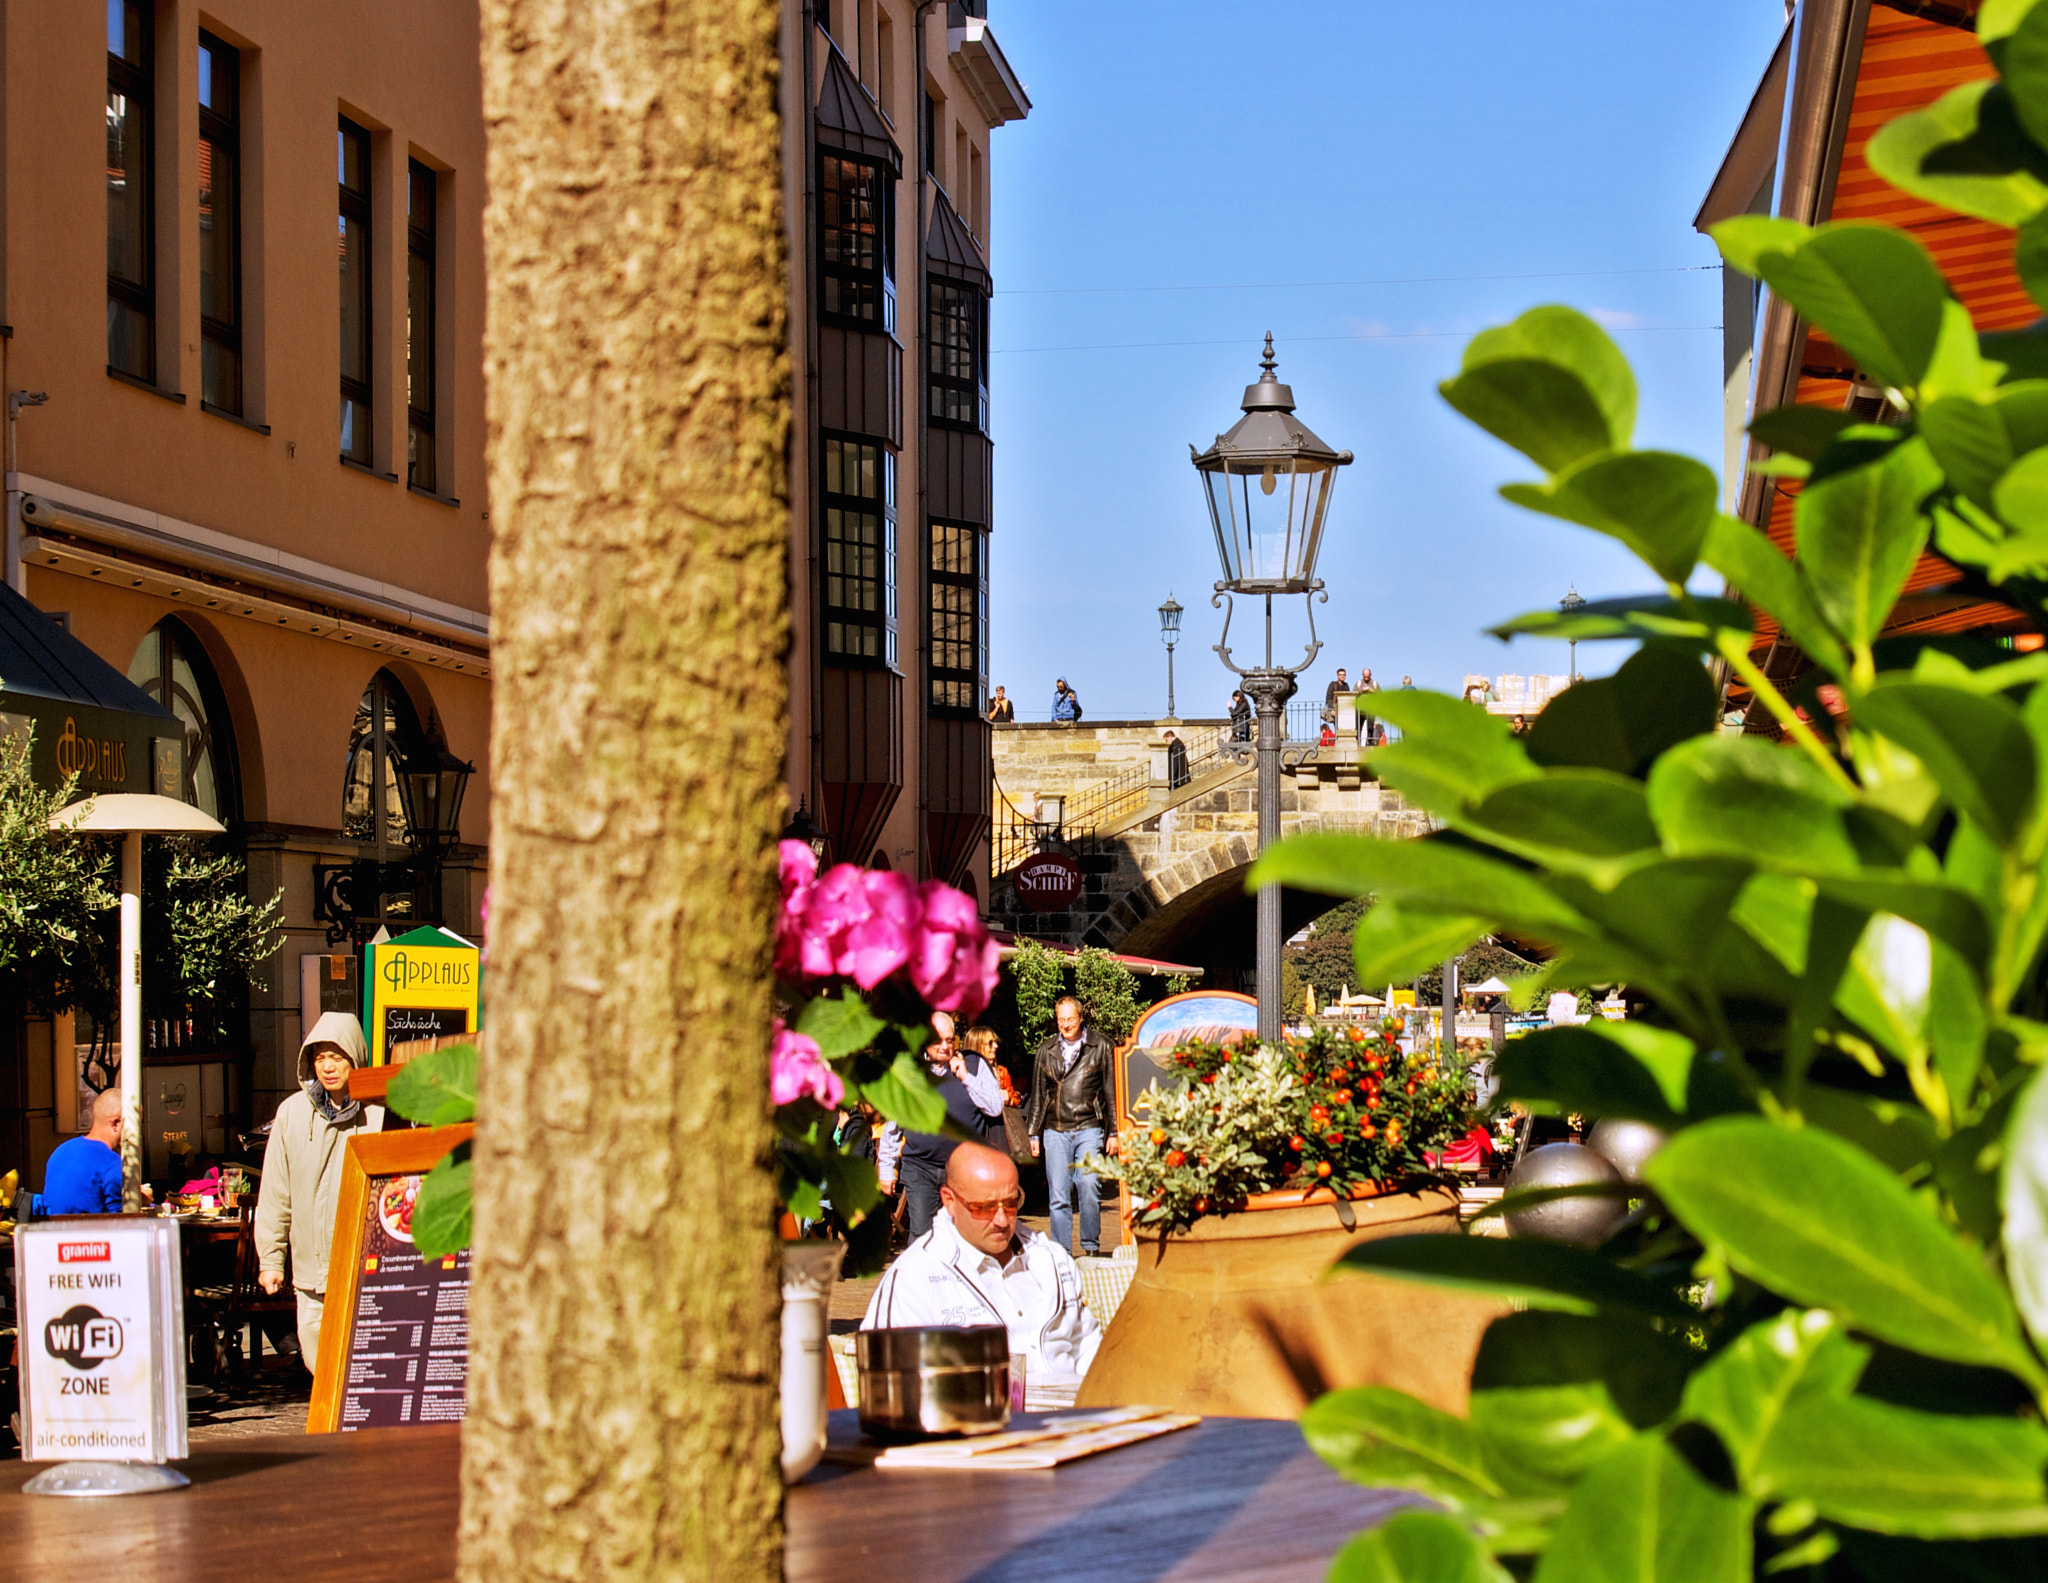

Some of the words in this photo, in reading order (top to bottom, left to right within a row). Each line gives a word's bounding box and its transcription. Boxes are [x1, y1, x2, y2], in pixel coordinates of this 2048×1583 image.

[57, 716, 126, 783] APPLAUS
[1019, 870, 1078, 891] SCHIFF
[383, 951, 470, 992] APPLAUS
[62, 1242, 105, 1261] granini
[49, 1274, 83, 1289] FREE
[88, 1273, 122, 1288] WIFI
[60, 1377, 110, 1395] ZONE
[37, 1431, 146, 1447] air-conditioned
